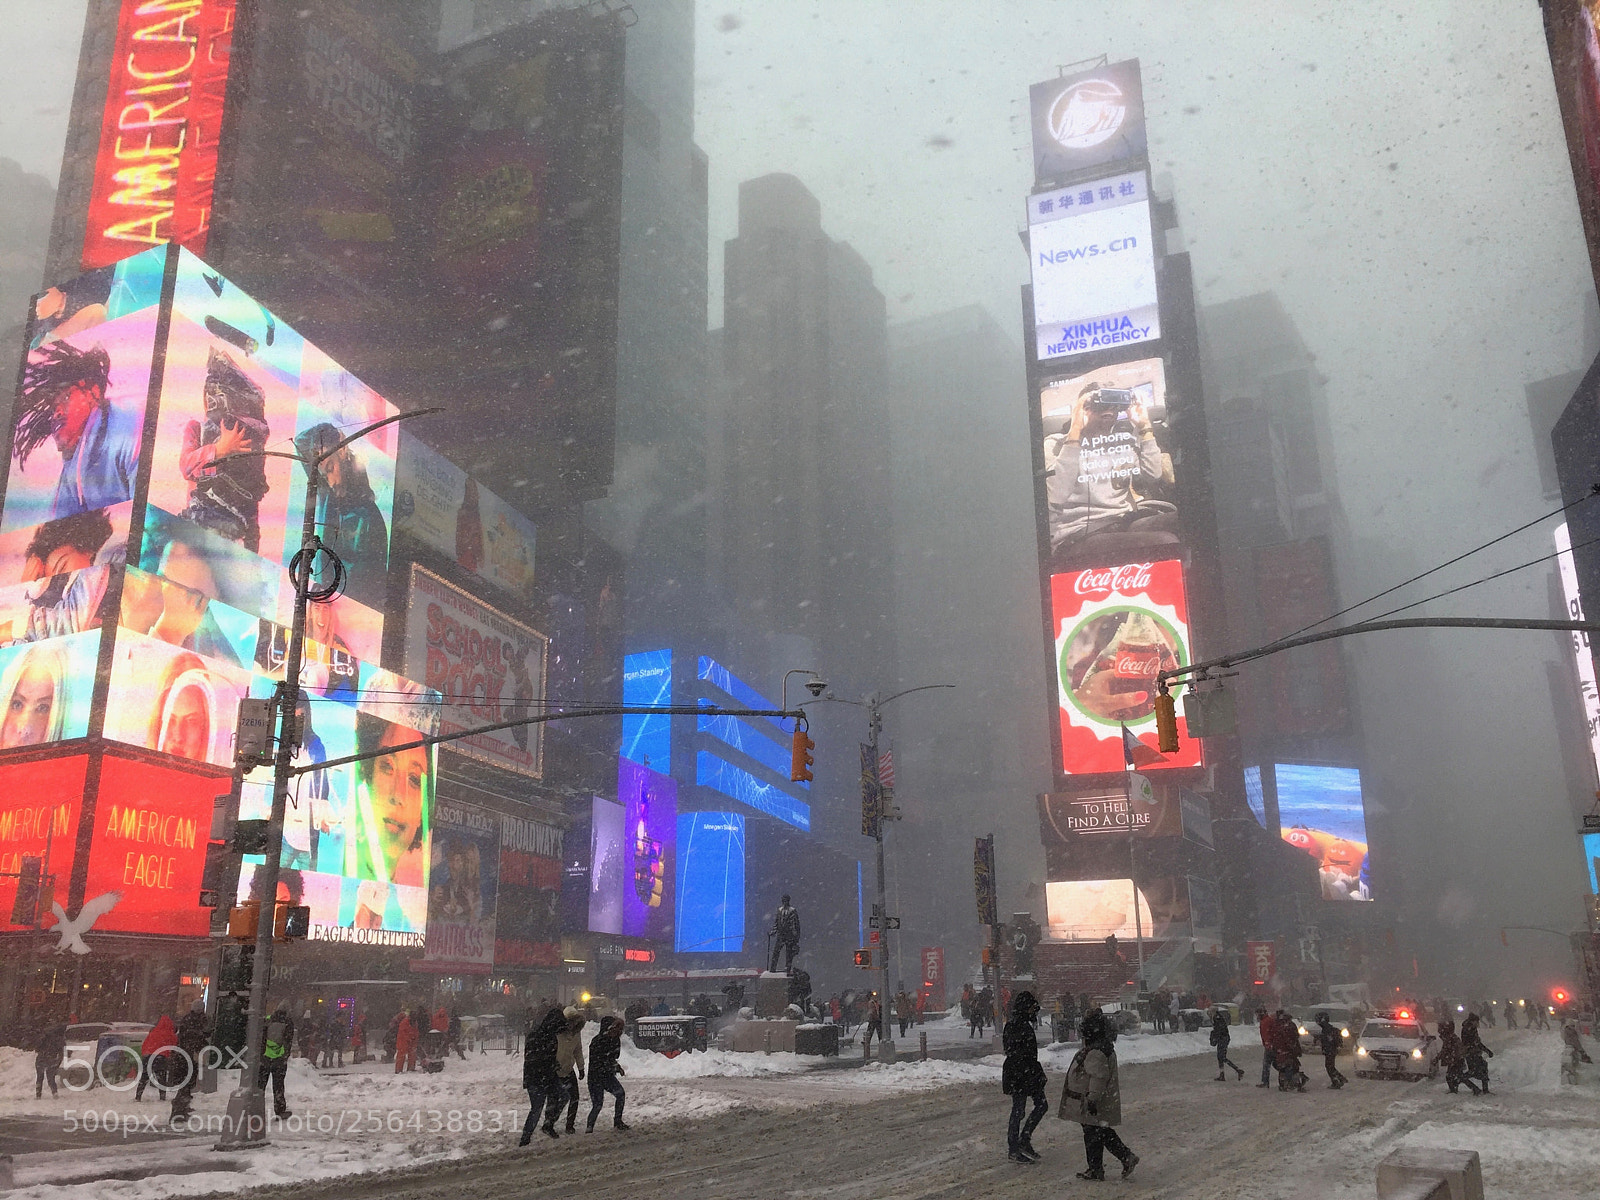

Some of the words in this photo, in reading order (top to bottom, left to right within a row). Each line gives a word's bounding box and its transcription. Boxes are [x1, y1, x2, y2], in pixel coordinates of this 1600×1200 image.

[1038, 180, 1135, 215] 新华通讯社
[1039, 236, 1137, 267] News.cn
[1047, 338, 1088, 355] NEWS
[1091, 326, 1150, 347] AGENCY
[1062, 315, 1133, 341] XINHUA
[1080, 446, 1105, 459] that
[1107, 444, 1131, 455] can
[1081, 437, 1090, 447] A
[1092, 432, 1131, 448] phone
[1077, 466, 1141, 484] anywhere
[1082, 459, 1110, 471] take
[1111, 456, 1134, 469] you
[426, 602, 507, 680] SCHOOL
[424, 644, 505, 724] ROCK
[639, 667, 664, 680] Stanley
[434, 804, 464, 825] ASON
[465, 812, 494, 832] MRAZ
[1067, 816, 1099, 828] FIND
[1102, 814, 1112, 826] A
[1115, 813, 1150, 825] CURE
[1082, 804, 1099, 814] TO
[105, 805, 198, 850] AMERICAN
[500, 815, 564, 860] BROADWAY'S
[123, 852, 176, 889] EAGLE
[314, 924, 354, 943] EAGLE
[356, 928, 425, 949] OUTFITTERS
[425, 920, 484, 958] WAITRESS
[926, 951, 939, 980] tkts
[1254, 944, 1270, 980] tkts
[638, 1023, 680, 1032] BROADWAY'S
